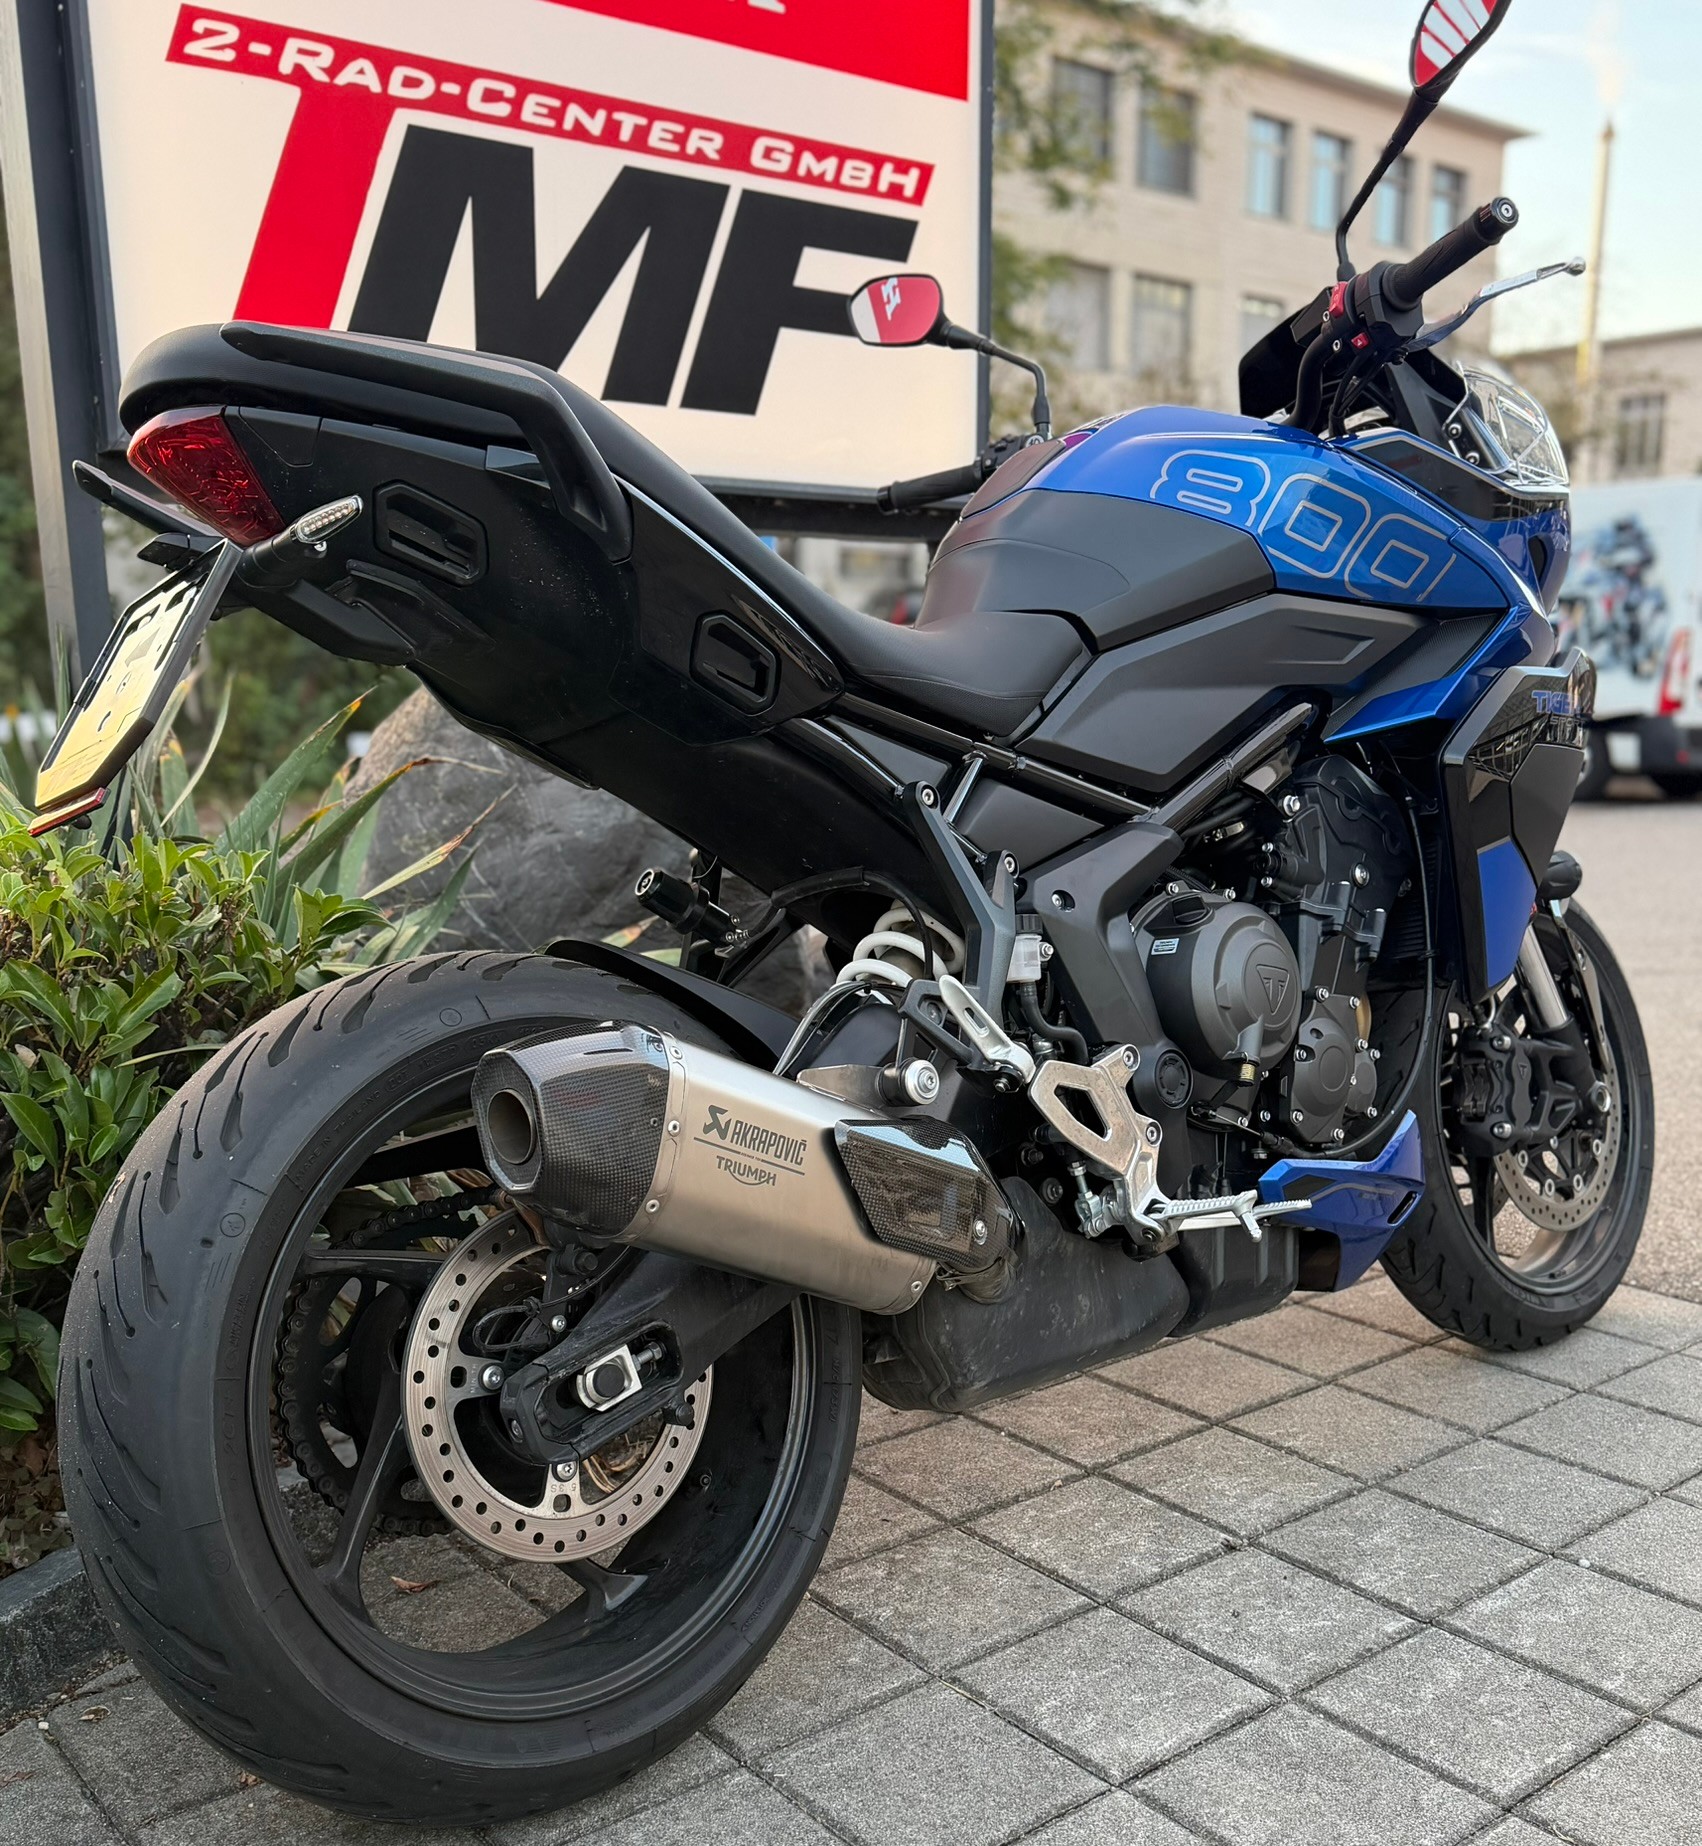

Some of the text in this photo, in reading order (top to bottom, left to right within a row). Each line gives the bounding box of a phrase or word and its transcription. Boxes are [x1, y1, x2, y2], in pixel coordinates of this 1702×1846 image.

[232, 88, 920, 416] TMF
[1150, 449, 1458, 602] 800
[716, 1155, 777, 1187] TRIUMPH
